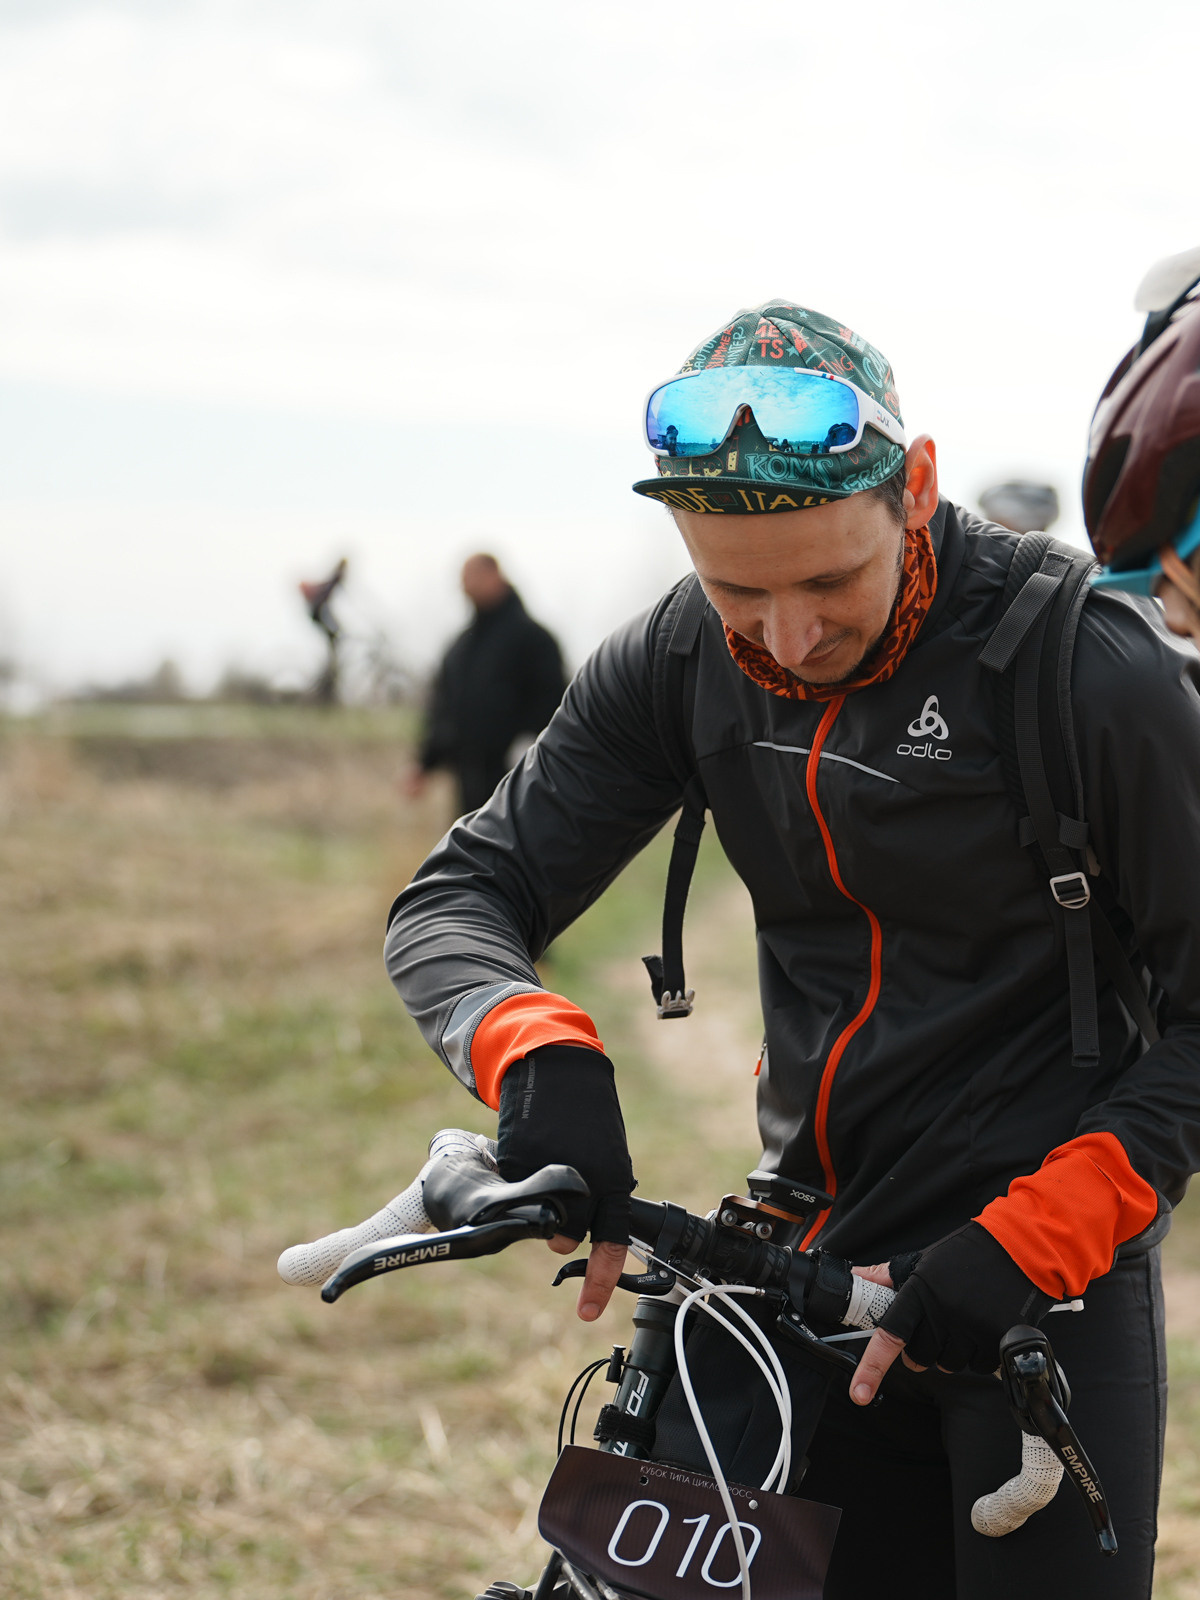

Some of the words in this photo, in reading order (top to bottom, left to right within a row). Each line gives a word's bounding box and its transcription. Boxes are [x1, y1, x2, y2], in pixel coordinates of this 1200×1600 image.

[745, 453, 834, 490] KOMS
[645, 487, 725, 513] RIDE
[896, 742, 952, 760] odlo
[790, 1189, 816, 1203] XOSS
[373, 1242, 451, 1271] EMPIRE
[640, 1465, 667, 1479] КУБОК
[669, 1472, 691, 1484] ТИПА
[691, 1478, 753, 1499] ЦИКЛОРОСС
[1060, 1445, 1103, 1504] EMPIRE
[607, 1499, 762, 1588] 010
